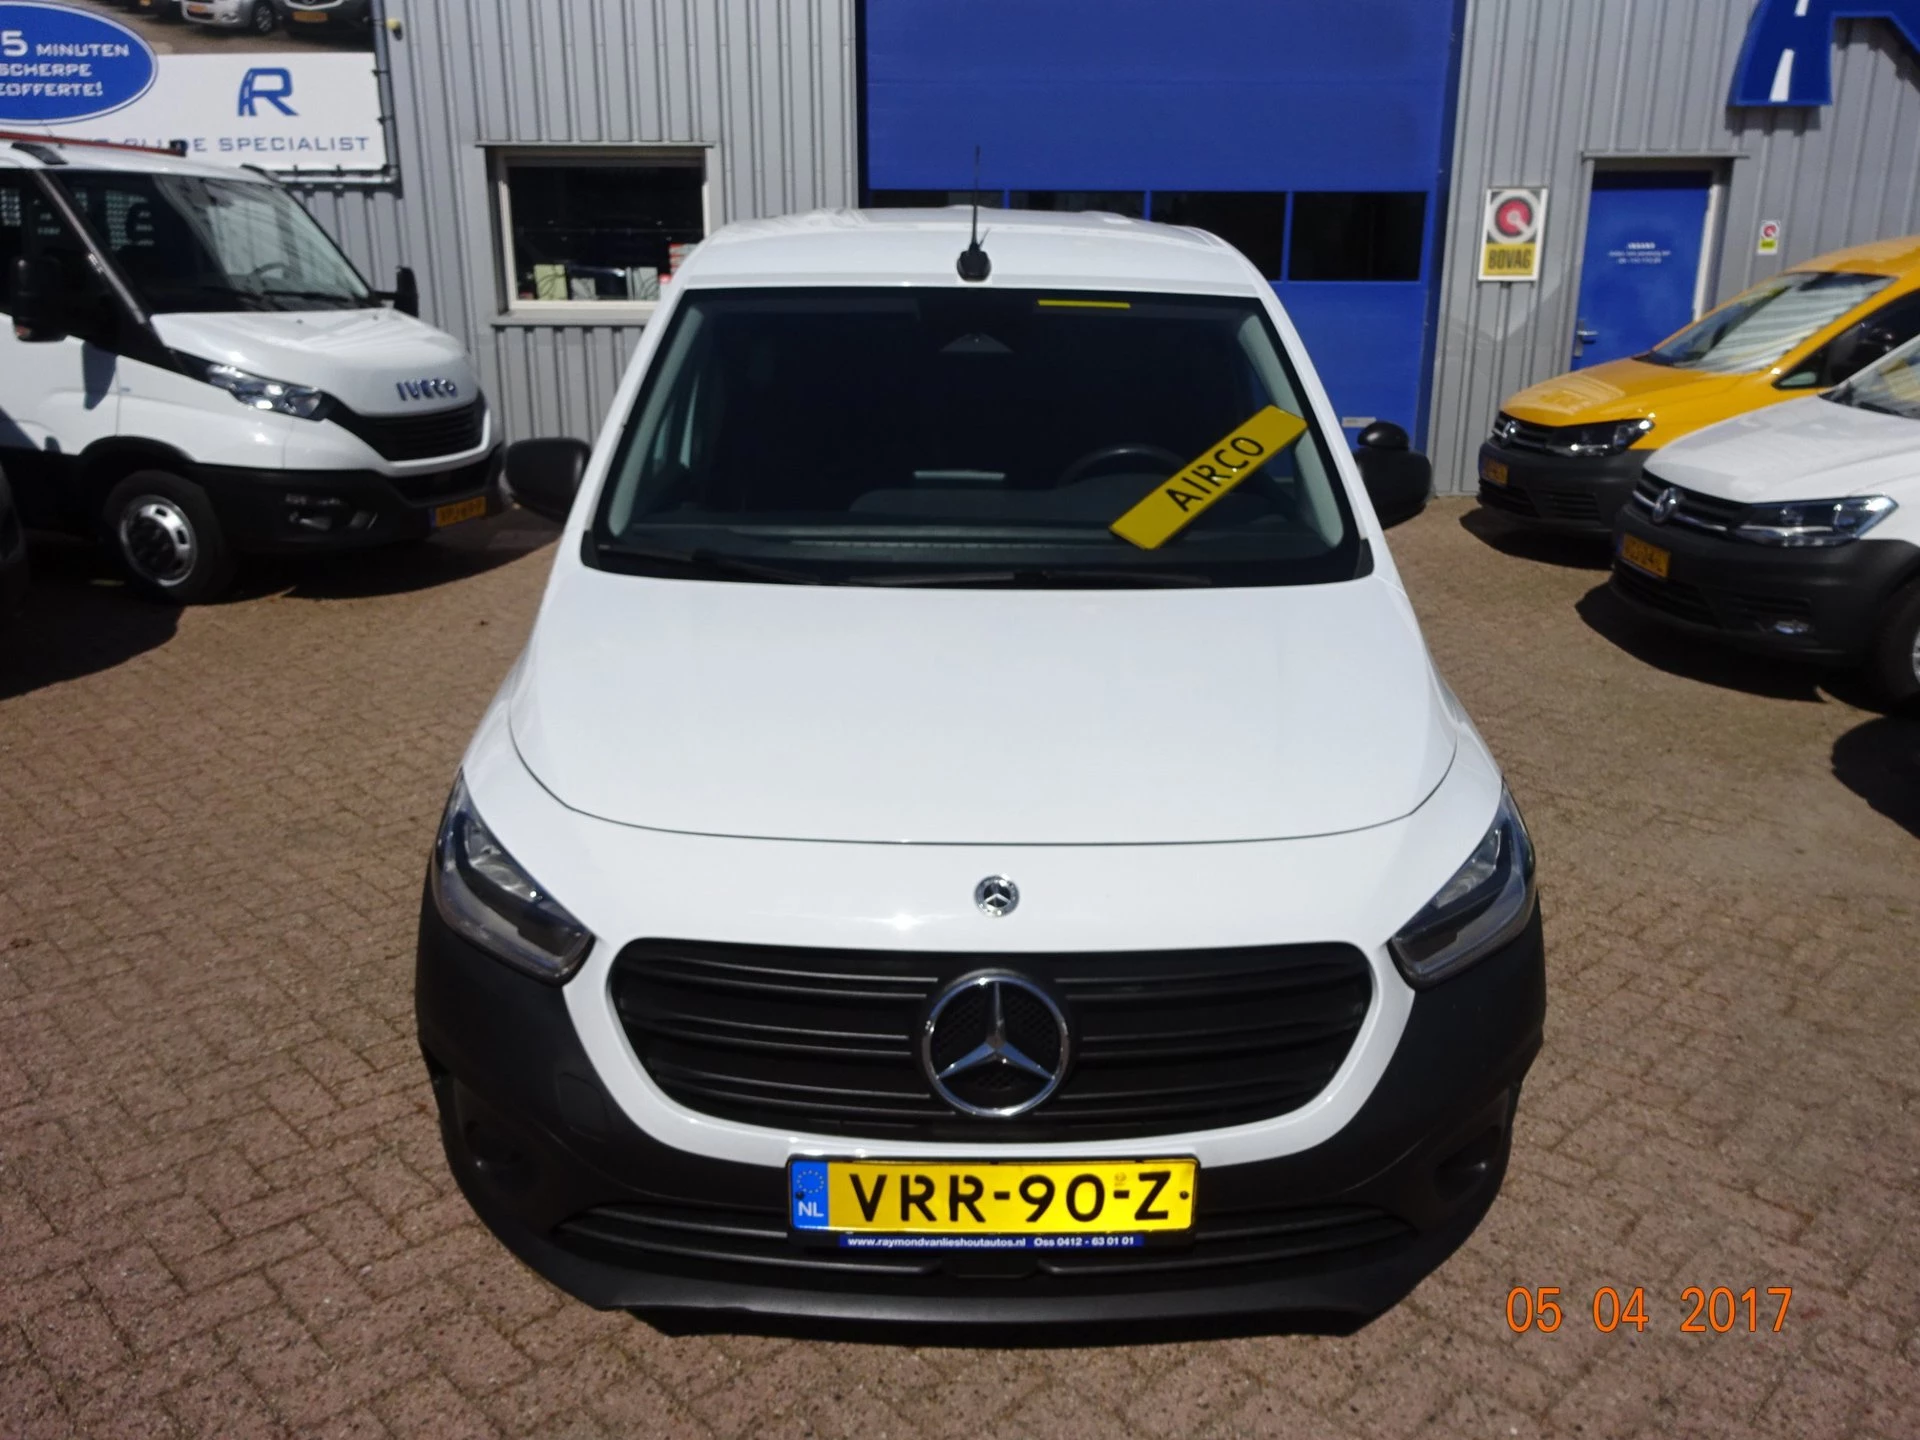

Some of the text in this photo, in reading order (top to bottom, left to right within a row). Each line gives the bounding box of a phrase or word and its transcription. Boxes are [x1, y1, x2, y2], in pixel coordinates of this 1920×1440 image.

[35, 43, 130, 57] MINUTEN
[0, 63, 92, 77] SCHERPE
[218, 136, 369, 152] SPECIALIST
[1487, 248, 1532, 270] BOVAG
[396, 378, 458, 401] IVECO
[1165, 436, 1264, 513] AIRCO
[848, 1170, 1172, 1224] VRR-90-Z
[798, 1200, 825, 1217] NL
[847, 1236, 1026, 1249] www.raymondvanlieshoutautos.nl
[1033, 1237, 1056, 1247] Oss
[1057, 1237, 1083, 1247] 0412
[1091, 1236, 1105, 1247] 63
[1106, 1236, 1119, 1246] 01
[1121, 1236, 1134, 1246] 01
